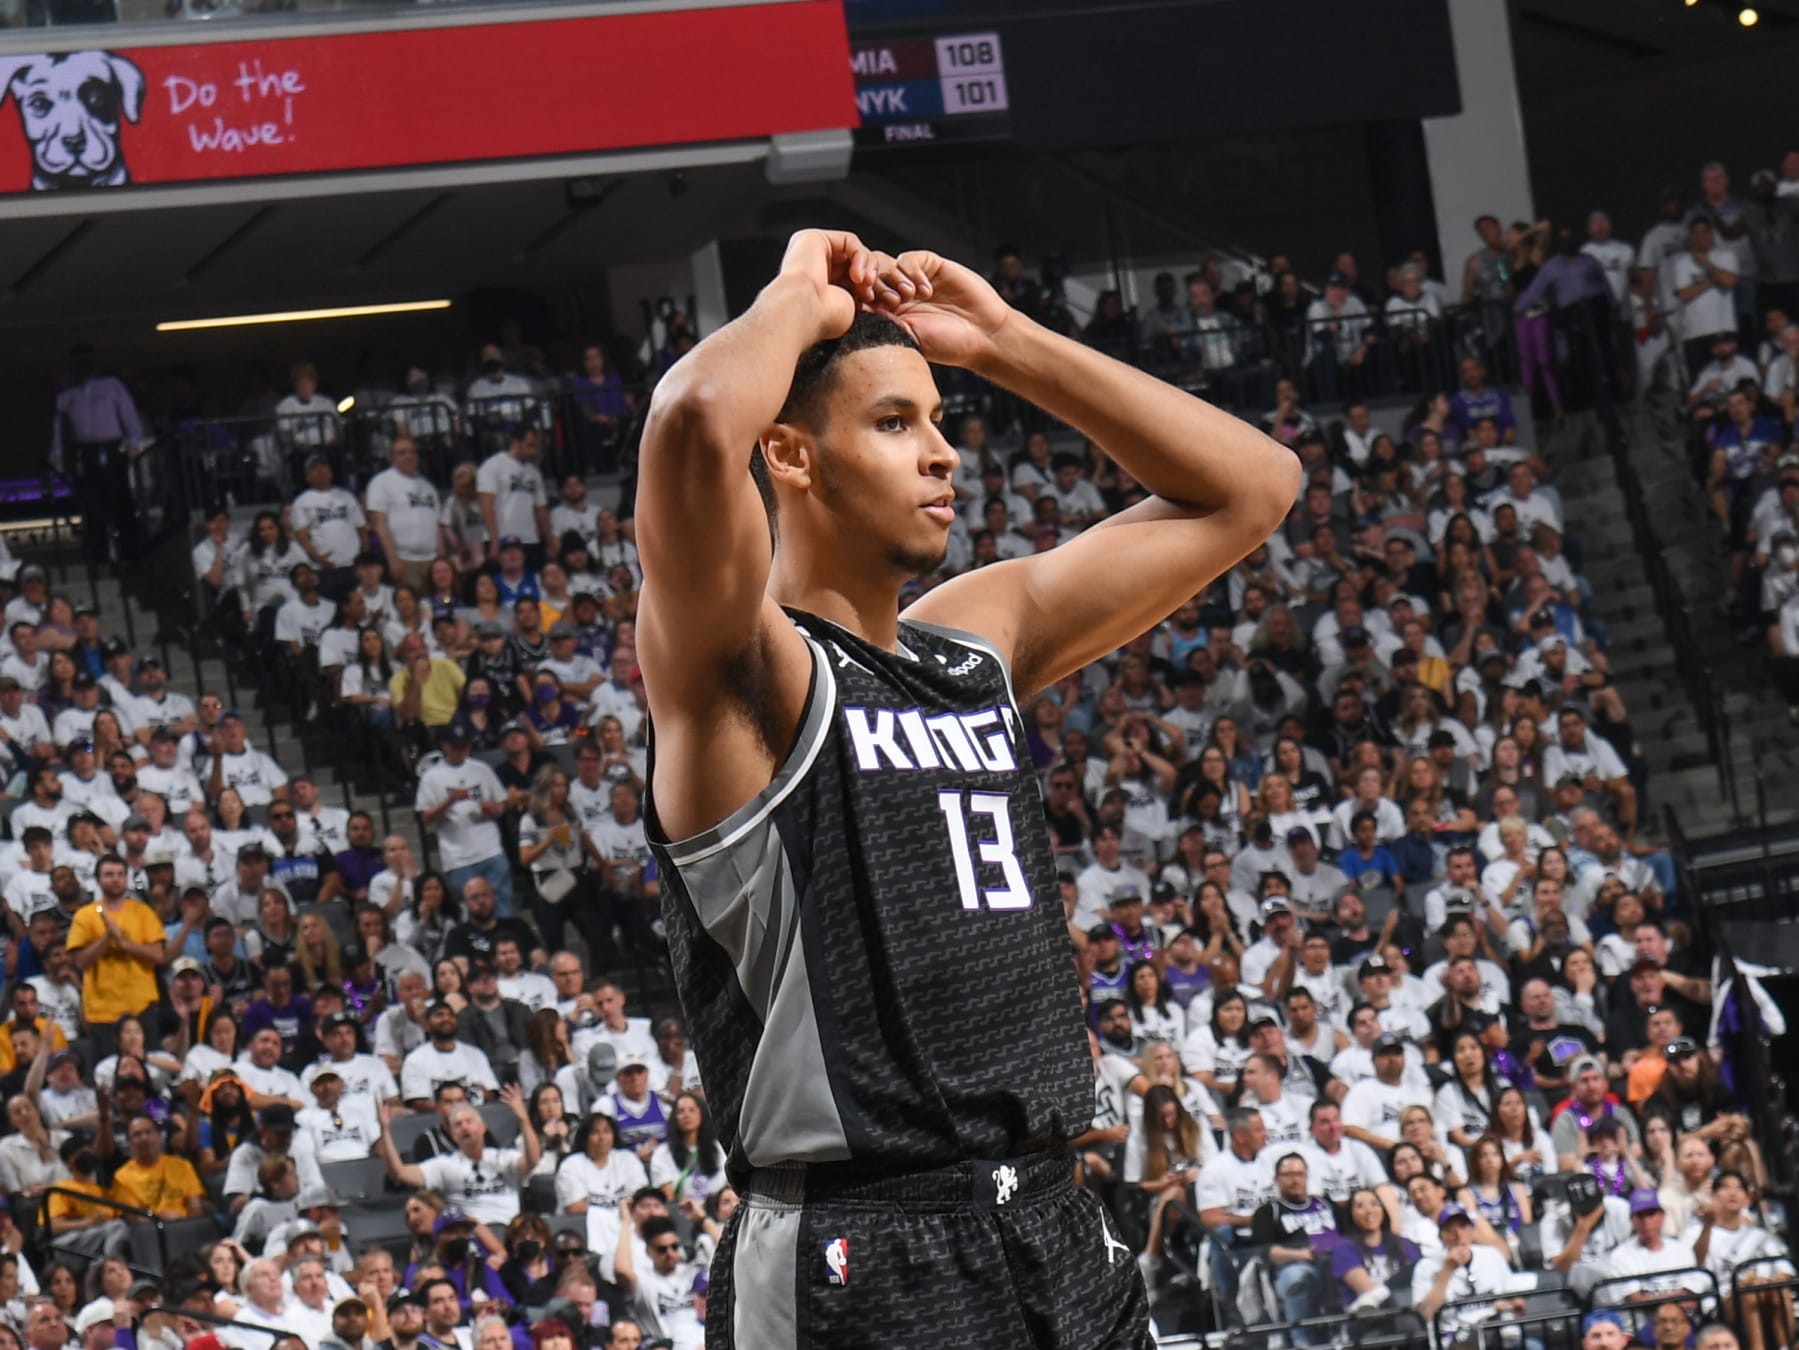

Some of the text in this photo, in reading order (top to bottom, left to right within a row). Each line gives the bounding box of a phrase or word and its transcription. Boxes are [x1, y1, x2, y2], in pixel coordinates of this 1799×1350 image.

[848, 41, 994, 75] MIA 108
[162, 57, 307, 115] Do the
[854, 81, 998, 115] NYK 101
[188, 96, 296, 153] Wave!
[884, 123, 936, 142] FINAL
[937, 788, 1034, 912] 13
